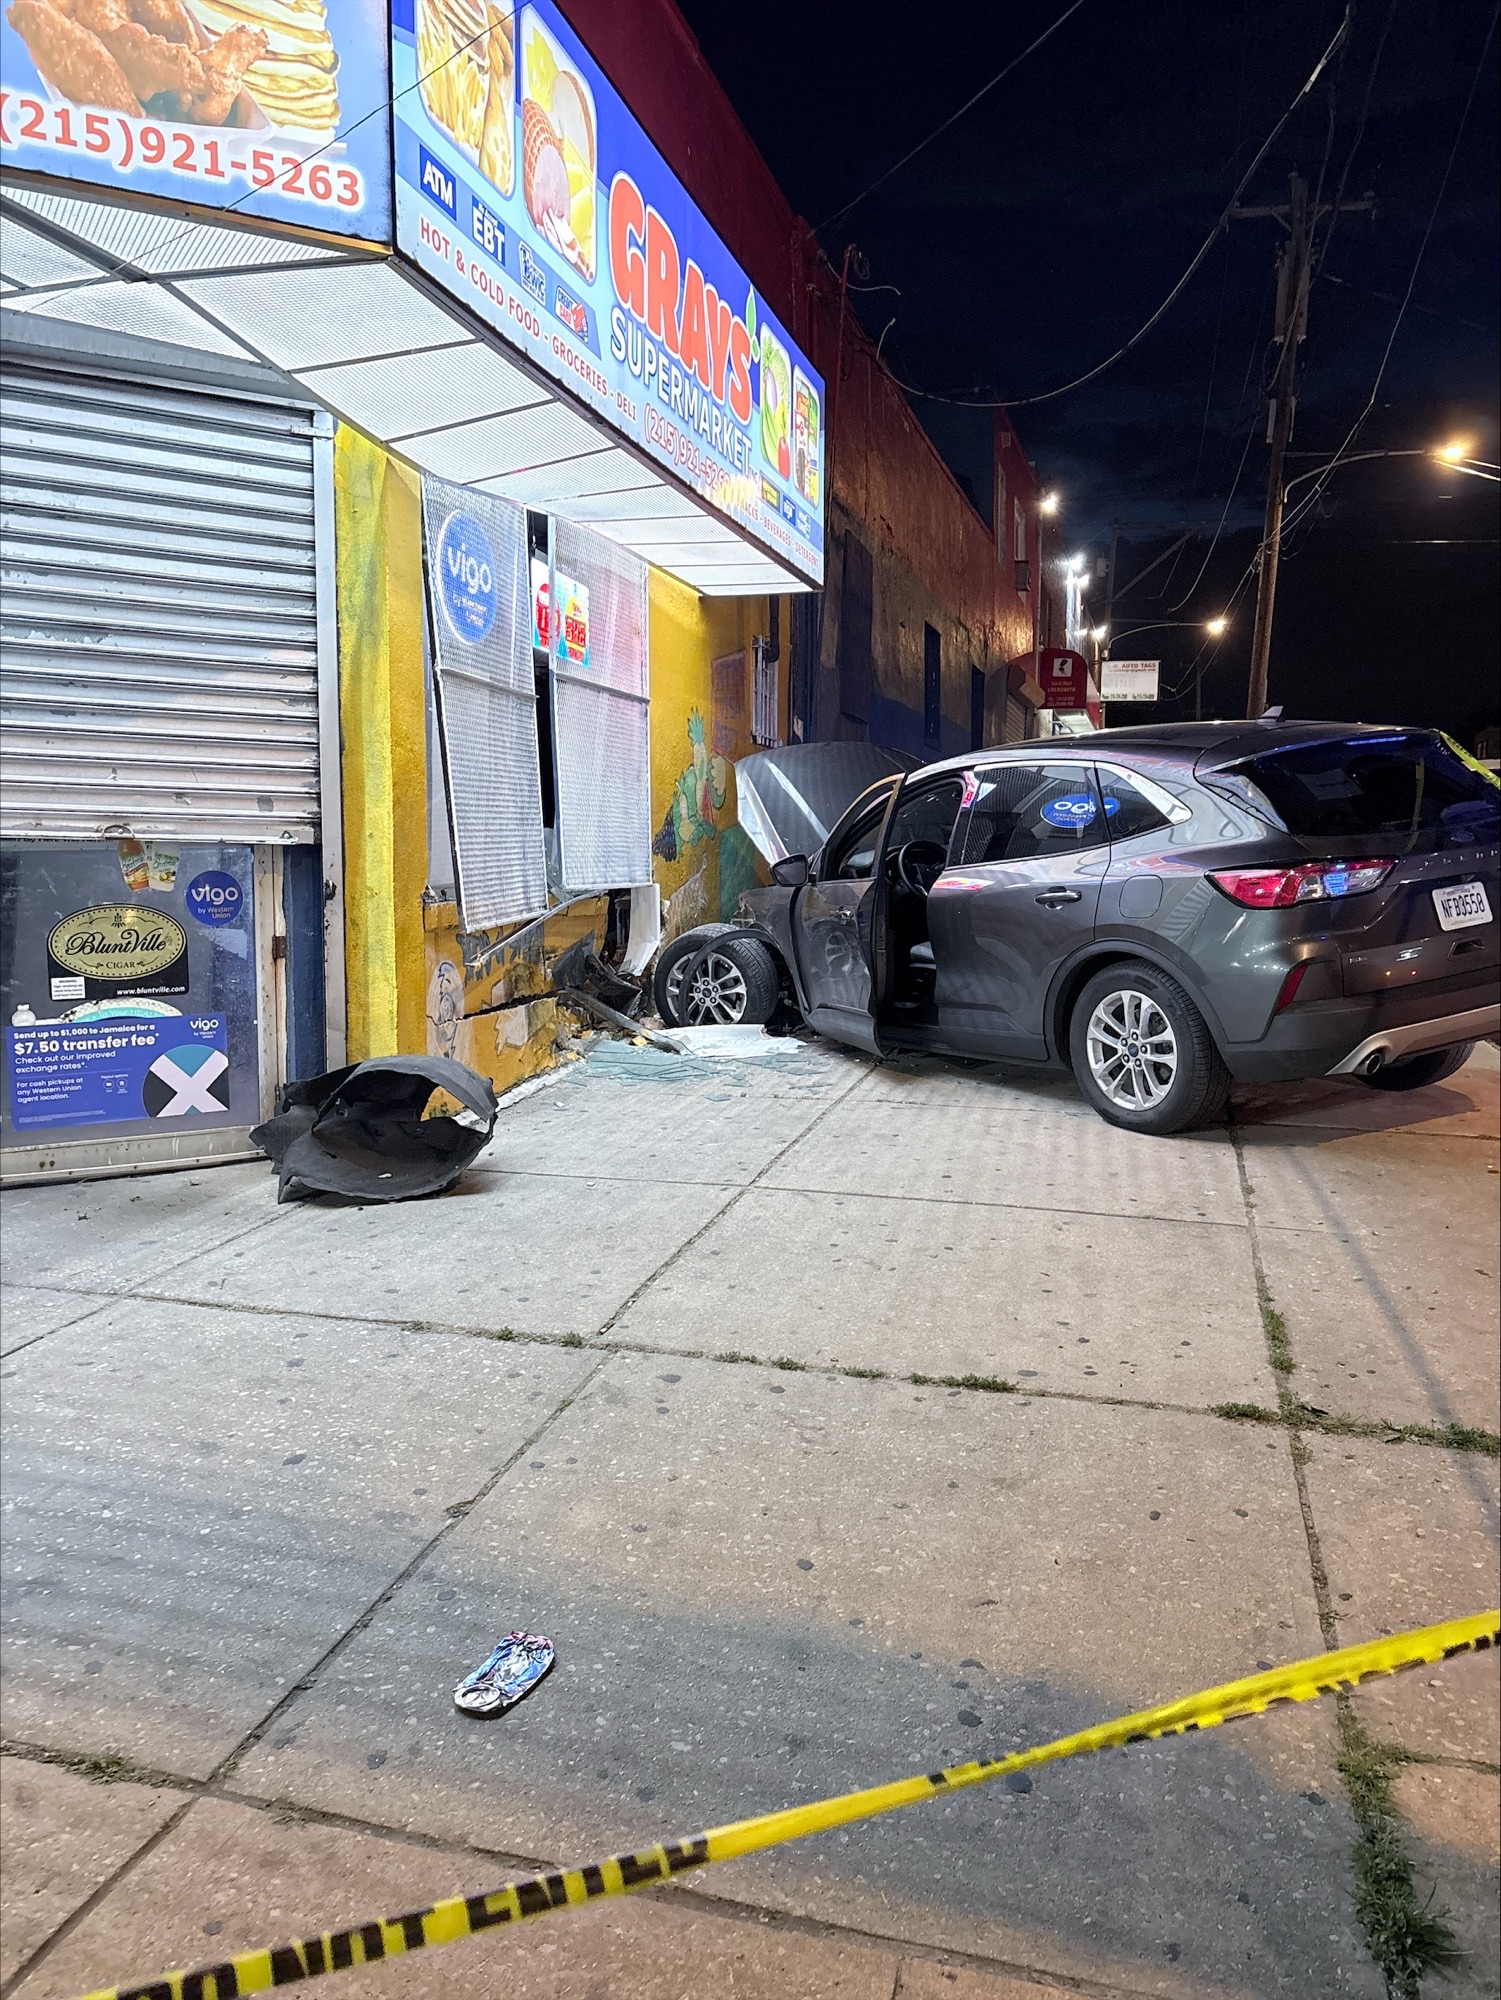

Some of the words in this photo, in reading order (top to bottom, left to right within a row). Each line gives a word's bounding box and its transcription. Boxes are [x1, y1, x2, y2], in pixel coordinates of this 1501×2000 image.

[0, 93, 360, 205] (215)921-5263
[423, 160, 453, 208] ATM
[473, 205, 505, 262] EBT
[421, 217, 450, 260] HOT
[456, 249, 465, 275] &
[471, 263, 504, 306] COLD
[508, 298, 540, 337] FOOD
[552, 337, 608, 399] GROCERIES
[616, 389, 637, 420] DELI
[559, 304, 571, 324] CARD
[611, 306, 752, 477] SUPERMARKET
[764, 516, 791, 546] BEVERAGES
[447, 543, 492, 595] vigo
[191, 883, 239, 905] vigo
[197, 907, 206, 915] by
[65, 927, 166, 955] BluntVille
[105, 961, 136, 970] CIGAR
[116, 985, 186, 996] www.bluntville.com
[14, 1031, 36, 1040] Send
[37, 1031, 49, 1040] up
[50, 1029, 59, 1037] to
[60, 1027, 88, 1038] $1,000
[99, 1025, 136, 1034] Jamaica
[190, 1017, 219, 1031] vigo
[14, 1040, 60, 1056] $7.50
[62, 1035, 129, 1051] transfer
[15, 1054, 43, 1065] Check
[44, 1054, 59, 1062] out
[60, 1053, 75, 1061] our
[76, 1050, 116, 1061] improved
[15, 1063, 59, 1074] exchange
[29, 1080, 46, 1088] cash
[47, 1078, 75, 1087] pickups
[31, 1087, 61, 1095] Western
[17, 1096, 39, 1104] agent
[39, 1093, 70, 1101] location.
